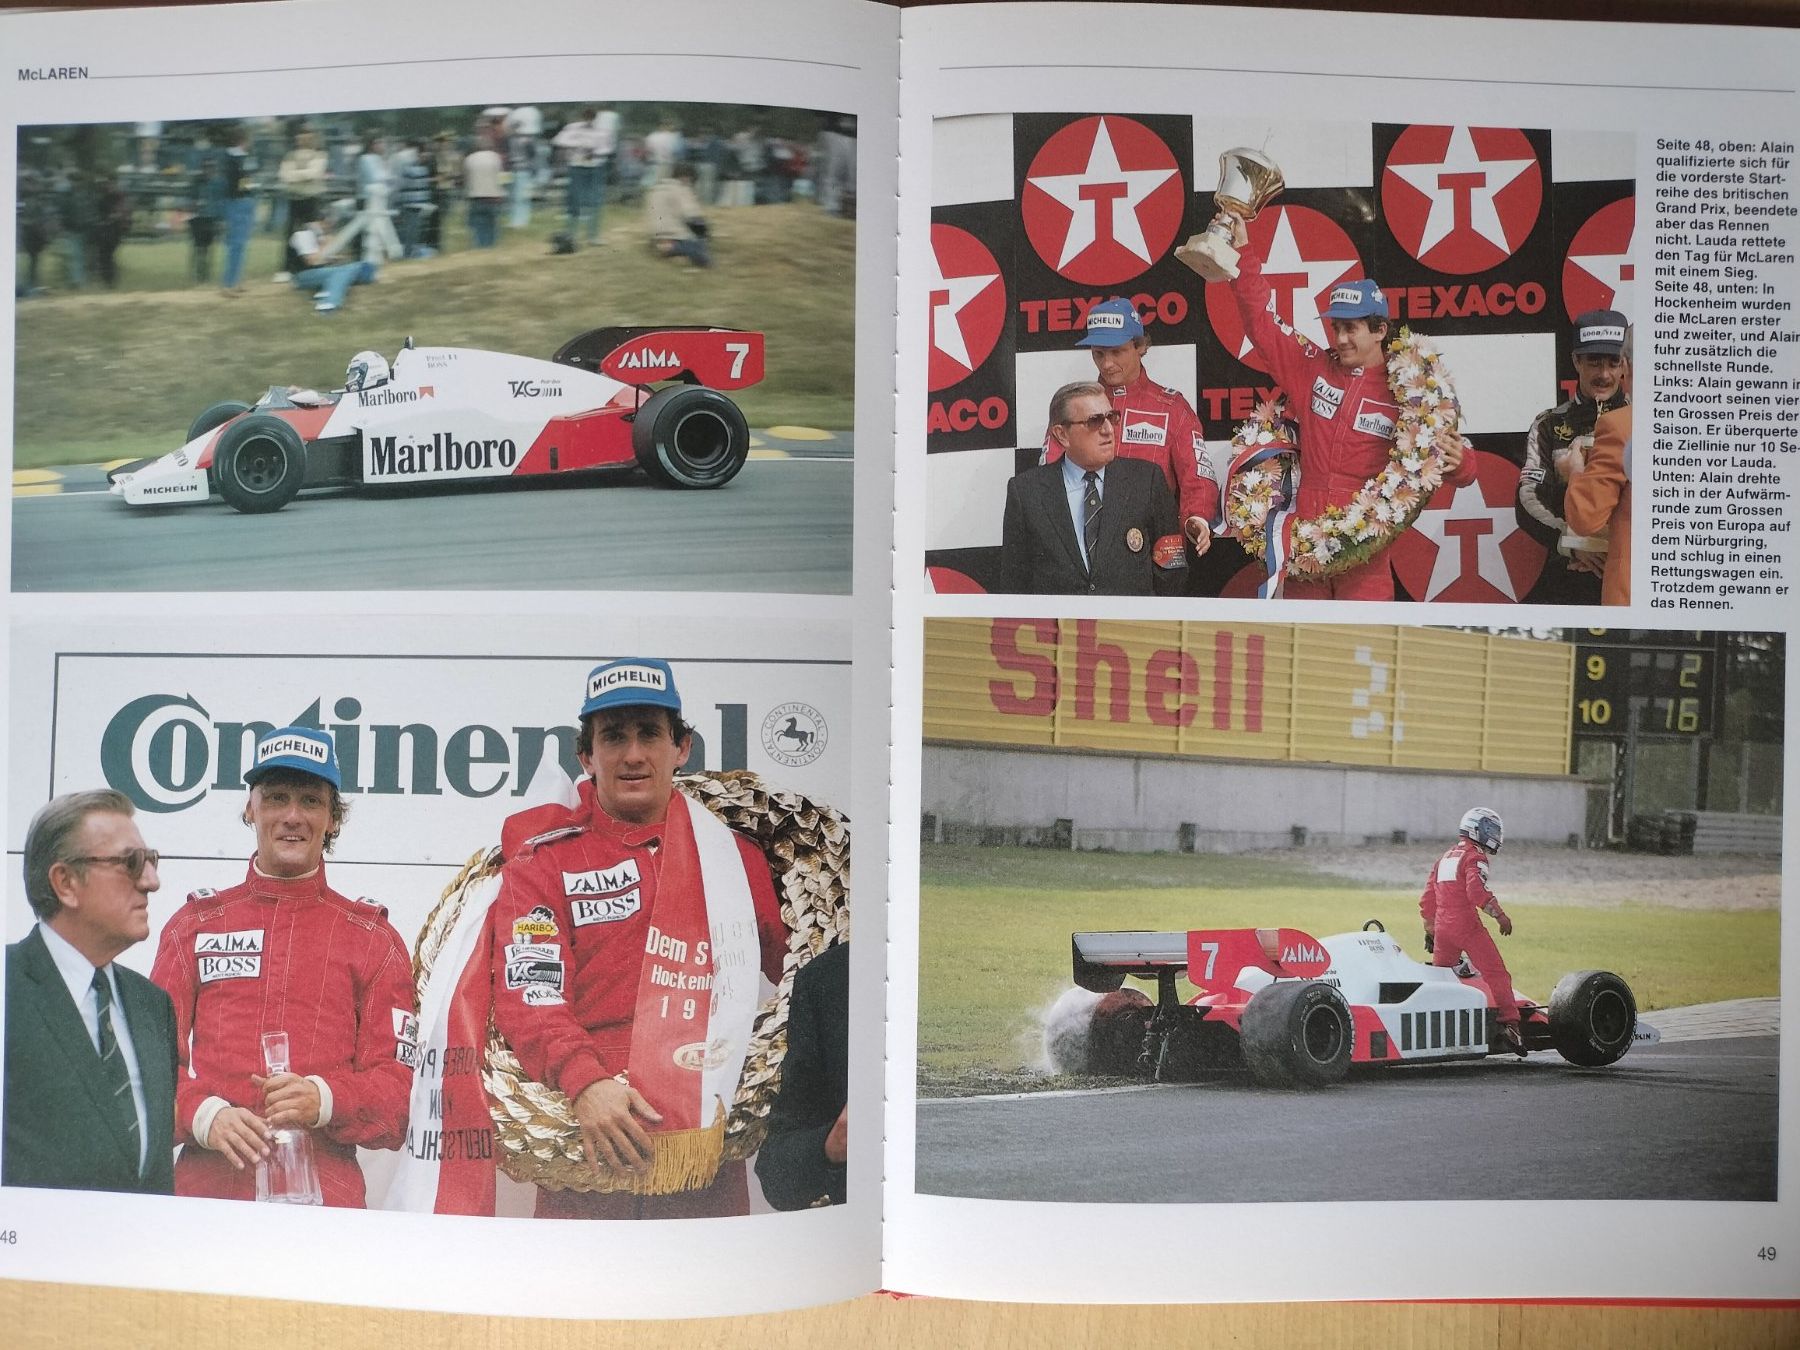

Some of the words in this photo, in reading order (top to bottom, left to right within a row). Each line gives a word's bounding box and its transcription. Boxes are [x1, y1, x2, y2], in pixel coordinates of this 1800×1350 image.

[18, 66, 89, 81] McLAREN
[1656, 138, 1690, 151] Seite
[1695, 140, 1714, 153] 48,
[1719, 140, 1756, 152] oben:
[1760, 141, 1794, 153] Alain
[1656, 155, 1735, 169] qualifizierte
[1740, 157, 1767, 168] sich
[1771, 157, 1790, 169] für
[1656, 170, 1676, 182] die
[1681, 171, 1744, 184] vorderste
[1749, 172, 1786, 184] Start-
[1656, 186, 1689, 198] reihe
[1693, 187, 1718, 199] des
[1723, 188, 1789, 200] britischen
[1655, 201, 1696, 214] Grand
[1701, 203, 1729, 217] Prix,
[1734, 204, 1798, 216] beendete
[1655, 217, 1686, 229] aber
[1689, 218, 1714, 230] das
[1718, 219, 1769, 231] Rennen
[1655, 233, 1691, 245] nicht.
[1696, 234, 1737, 246] Lauda
[1742, 236, 1786, 248] rettete
[1655, 249, 1680, 261] den
[1684, 250, 1710, 264] Tag
[1714, 250, 1732, 262] für
[1736, 251, 1794, 263] McLaren
[1655, 265, 1675, 276] mit
[1679, 265, 1720, 277] einem
[1724, 266, 1757, 281] Sieg.
[1655, 280, 1689, 292] Seite
[1693, 282, 1712, 295] 48,
[1717, 283, 1758, 294] unten:
[1763, 283, 1774, 295] In
[1381, 281, 1547, 320] TEXACO
[1655, 296, 1737, 309] Hockenheim
[1741, 299, 1791, 311] wurden
[1019, 291, 1188, 333] TEXCO
[1654, 312, 1675, 324] die
[1679, 313, 1736, 325] McLaren
[1741, 315, 1781, 326] erster
[1654, 328, 1679, 340] und
[1683, 329, 1735, 343] zweiter,
[1740, 330, 1765, 341] und
[1654, 343, 1681, 355] fuhr
[1685, 345, 1752, 357] zusätzlich
[1756, 346, 1777, 358] die
[725, 343, 750, 379] 7
[1654, 360, 1722, 372] schnellste
[1727, 361, 1773, 374] Runde.
[507, 380, 541, 398] TAG
[1654, 375, 1693, 387] Links:
[1697, 376, 1731, 389] Alain
[1736, 380, 1788, 392] gewann
[358, 389, 417, 408] Marlboro
[1653, 391, 1722, 404] Zandvoort
[1726, 393, 1770, 405] seinen
[1653, 407, 1674, 419] ten
[1678, 407, 1734, 420] Grossen
[1739, 409, 1772, 421] Preis
[1777, 410, 1799, 422] der
[1126, 427, 1163, 441] Marlboro
[1653, 422, 1702, 435] Saison.
[1706, 424, 1721, 436] Er
[1725, 424, 1798, 439] überquerte
[1653, 438, 1673, 450] die
[1678, 439, 1730, 452] Ziellinie
[1734, 443, 1756, 452] nur
[1760, 441, 1775, 453] 10
[370, 432, 516, 476] Marlboro
[1653, 454, 1702, 467] kunden
[1706, 458, 1728, 467] vor
[1731, 456, 1776, 469] Lauda.
[1652, 470, 1695, 483] Unten:
[1699, 471, 1733, 483] Alain
[1737, 472, 1781, 485] drehte
[143, 484, 198, 495] MICHELIN
[1652, 486, 1679, 498] sich
[1684, 487, 1695, 498] in
[1699, 487, 1722, 499] der
[1725, 488, 1791, 500] Aufwärm-
[1652, 502, 1690, 514] runde
[1694, 505, 1722, 515] zum
[1727, 503, 1783, 516] Grossen
[1652, 518, 1685, 530] Preis
[1689, 521, 1713, 530] von
[1718, 519, 1765, 534] Europa
[1769, 520, 1791, 532] auf
[1651, 533, 1680, 545] dem
[1685, 534, 1767, 550] Nürburgring,
[1651, 550, 1676, 561] und
[1680, 550, 1724, 565] schlug
[1729, 551, 1740, 562] in
[1744, 551, 1781, 563] einen
[1651, 565, 1755, 581] Rettungswagen
[1759, 567, 1783, 579] ein.
[1650, 581, 1714, 593] Trotzdem
[1719, 585, 1771, 597] gewann
[1775, 586, 1789, 595] er
[1650, 597, 1675, 609] das
[1679, 597, 1734, 610] Rennen.
[989, 617, 1265, 733] Shell
[1586, 654, 1607, 680] 9
[1679, 653, 1701, 688] 2
[593, 670, 661, 692] MICHELIN
[1578, 698, 1612, 724] 10
[1665, 698, 1700, 732] 16
[261, 739, 324, 759] MICHELIN
[577, 892, 635, 919] BOSS
[517, 923, 554, 932] HARIBO
[646, 925, 688, 963] Dem
[203, 957, 256, 976] BOSS
[1201, 942, 1219, 980] 7
[0, 1229, 17, 1245] 48
[1757, 1246, 1777, 1261] 49
